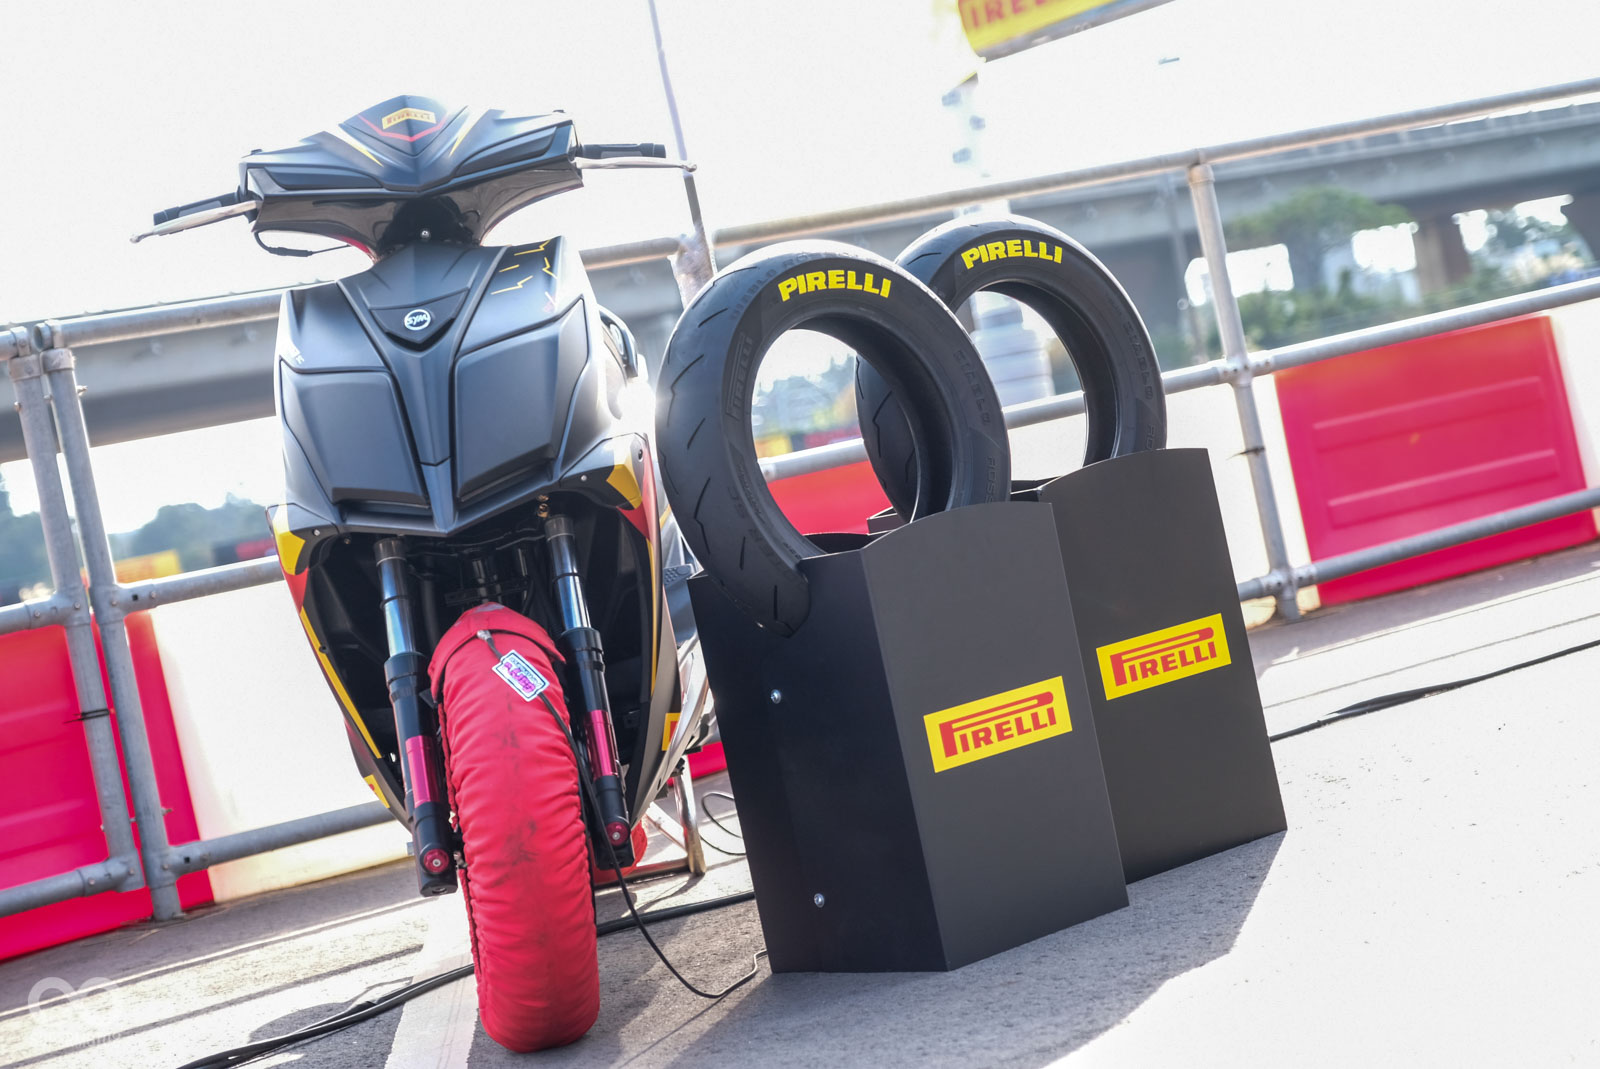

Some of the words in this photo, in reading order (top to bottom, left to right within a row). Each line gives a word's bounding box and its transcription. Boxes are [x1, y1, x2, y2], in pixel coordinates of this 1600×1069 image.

[962, 239, 1063, 269] PIRELLI
[779, 269, 892, 302] PIRELLI
[1110, 627, 1217, 687] PIRELLI
[939, 691, 1057, 758] PIRELLI
